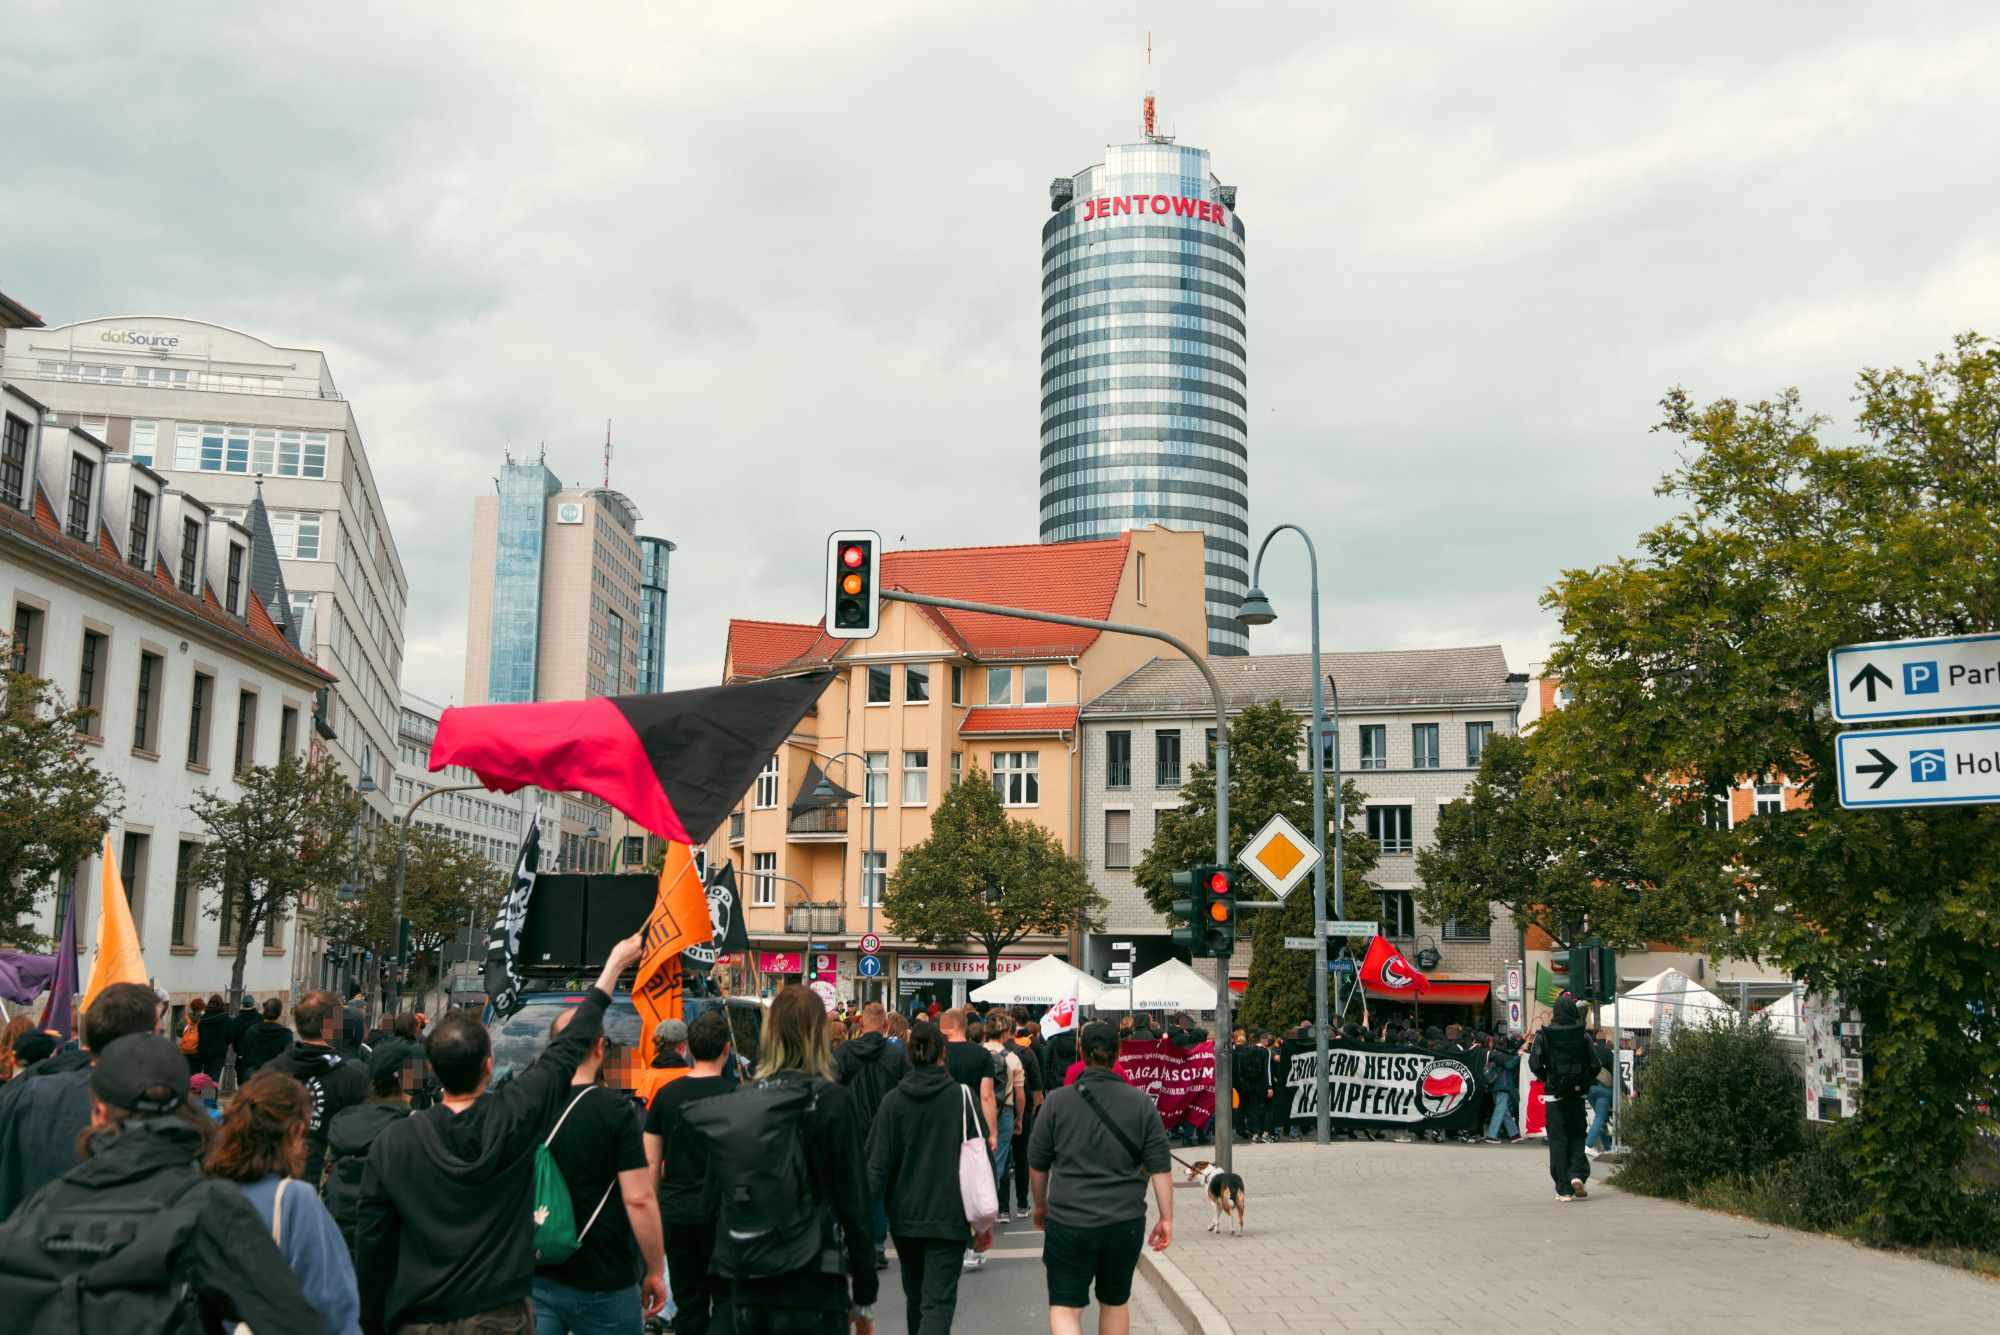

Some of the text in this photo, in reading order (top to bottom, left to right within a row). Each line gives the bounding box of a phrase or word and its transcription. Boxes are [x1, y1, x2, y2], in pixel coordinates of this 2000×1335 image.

[1083, 194, 1226, 227] JENTOWER
[1948, 661, 2000, 687] Par
[864, 938, 876, 949] 30
[930, 962, 1021, 973] BERUFSMDEN
[1022, 995, 1054, 1003] PAULANER
[1289, 1053, 1433, 1082] ERINERN HEISST
